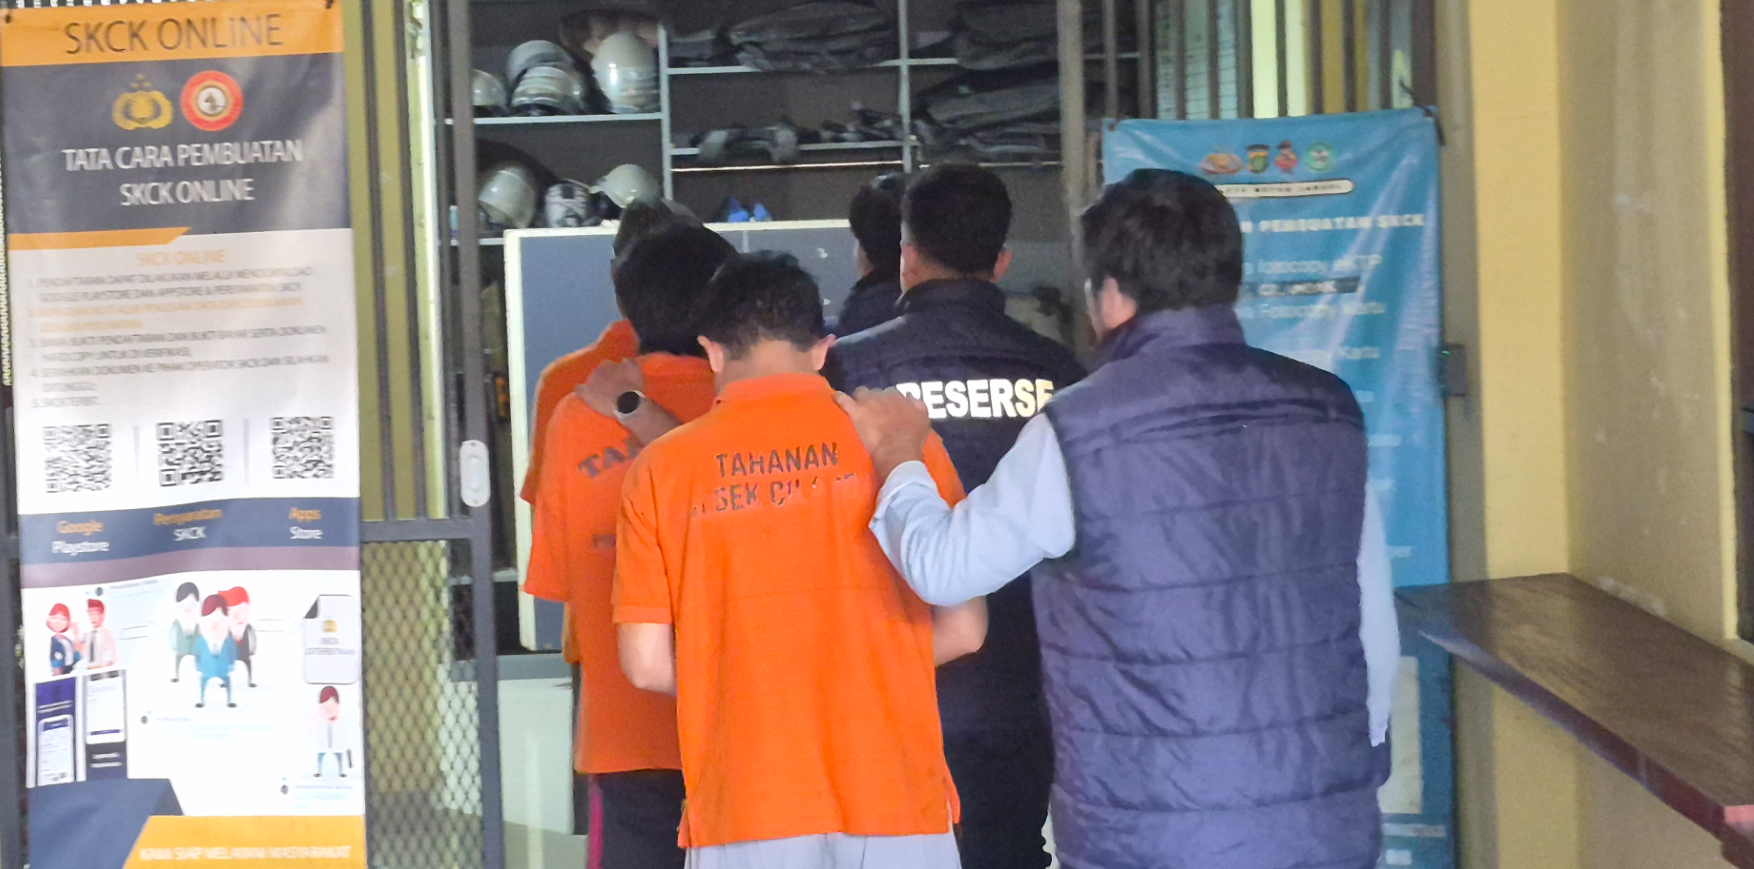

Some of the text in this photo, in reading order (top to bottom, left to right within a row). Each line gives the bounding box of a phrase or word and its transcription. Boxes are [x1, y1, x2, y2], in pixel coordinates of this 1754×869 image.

[65, 13, 283, 54] SKCK ONLINE
[62, 139, 304, 171] TATA CARA PEMBUATAN
[120, 178, 255, 206] SKCK ONLINE
[715, 442, 838, 478] TAHANAN
[56, 520, 103, 536] Google
[173, 526, 207, 541] SKCK
[289, 526, 323, 540] Store
[52, 540, 110, 556] Playstore
